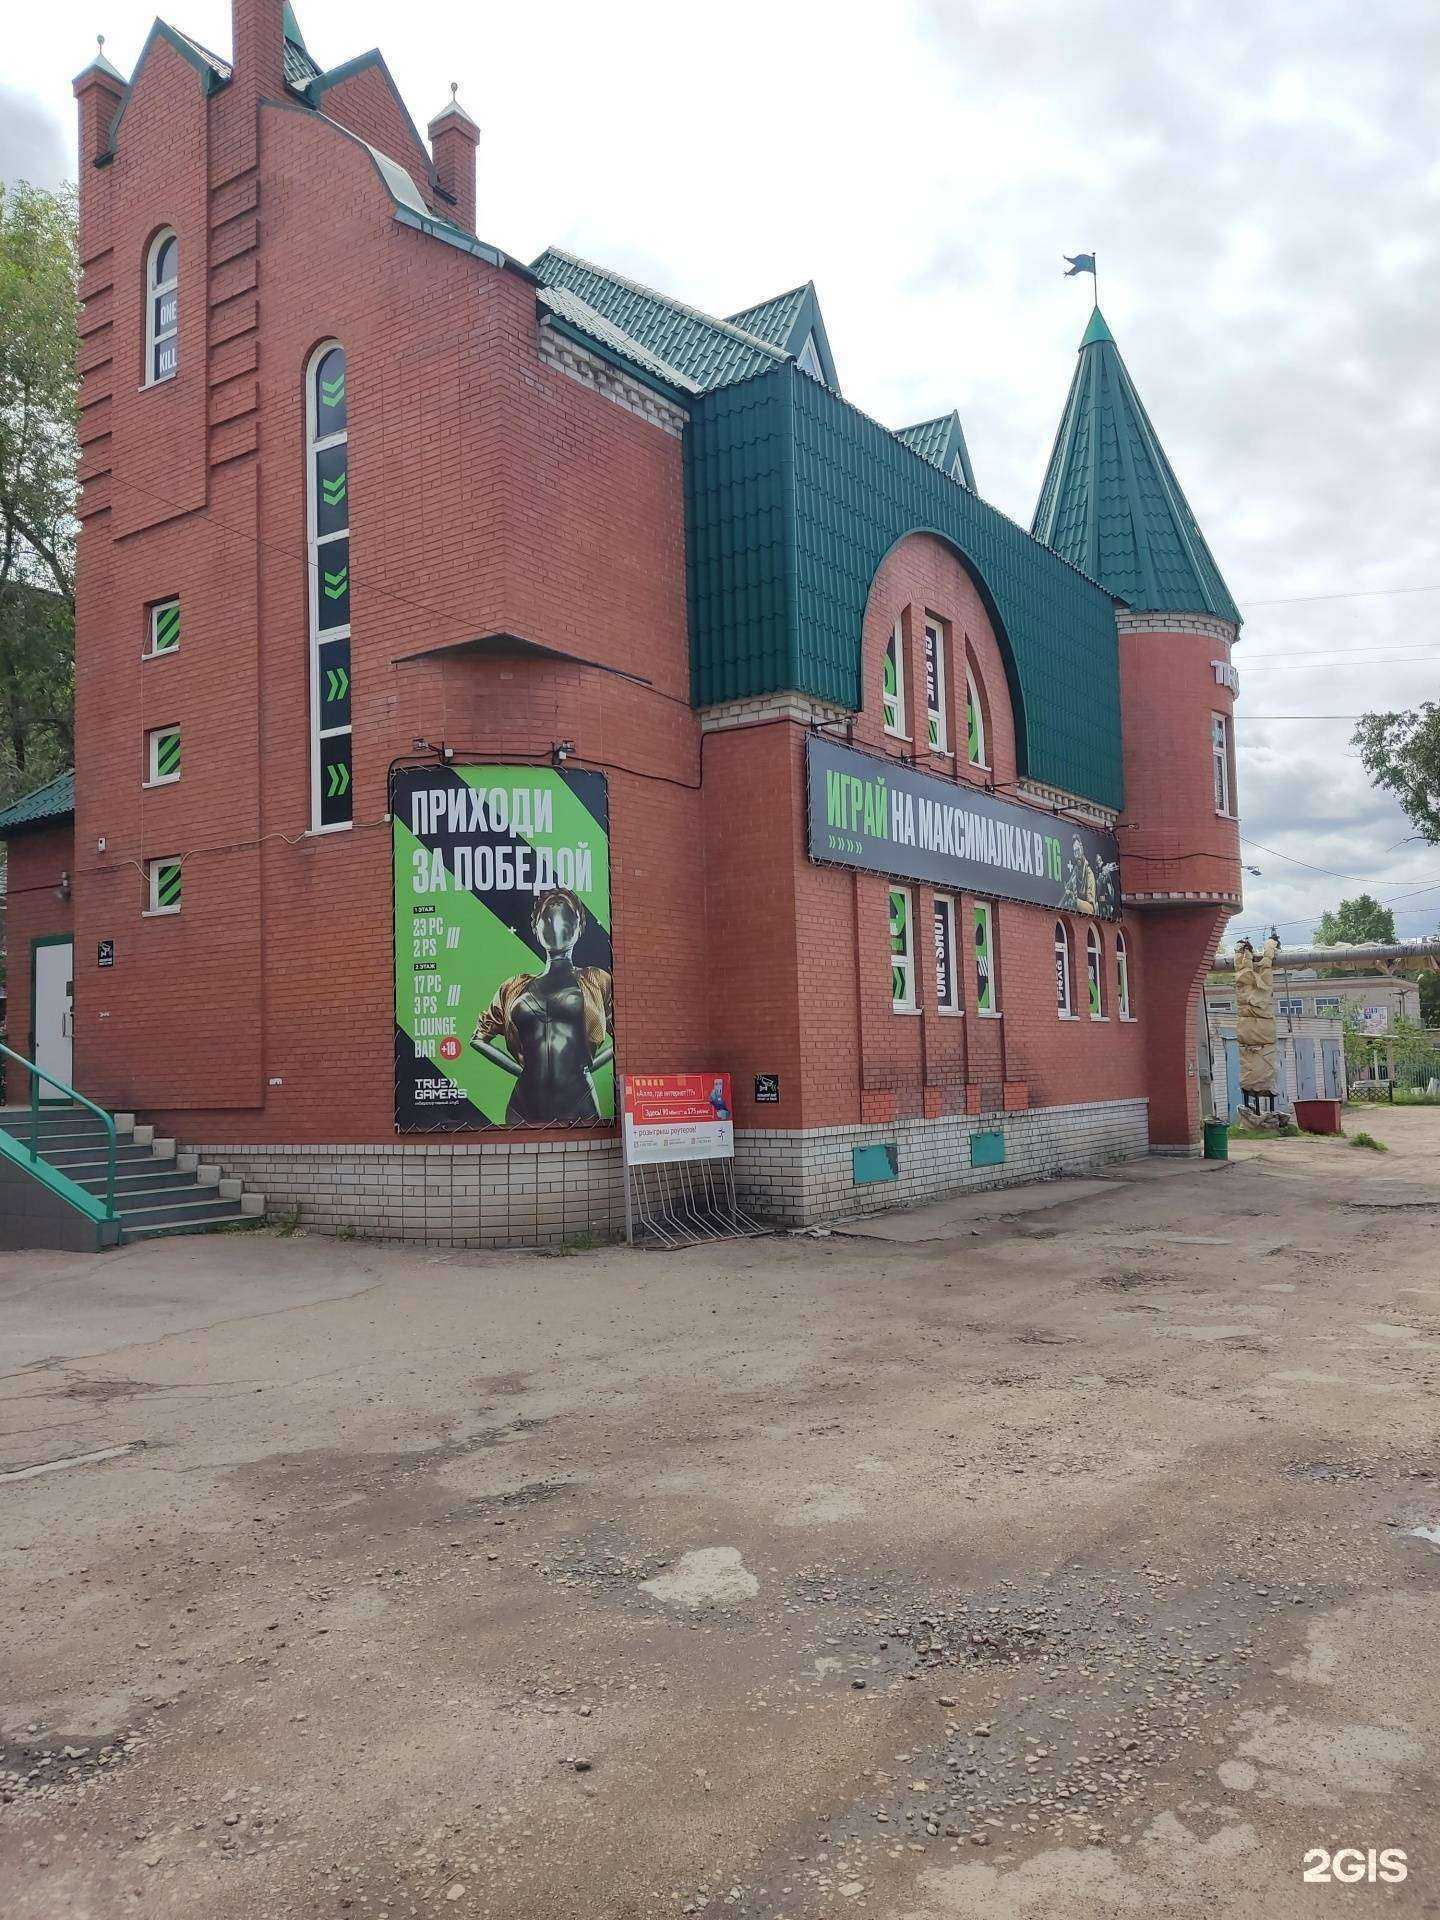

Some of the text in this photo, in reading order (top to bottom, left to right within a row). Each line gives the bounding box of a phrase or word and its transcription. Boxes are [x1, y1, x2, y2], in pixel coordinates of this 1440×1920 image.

[160, 301, 177, 326] ONE
[160, 348, 177, 372] KILL
[411, 787, 553, 838] ПРИХОДИ
[826, 769, 888, 840] ИГРАЙ
[892, 789, 916, 847] НА
[919, 797, 1034, 875] МАКСИМАЛКАХ
[1034, 832, 1044, 877] В
[412, 841, 593, 896] ЗА ПОБЕДОЙ
[412, 917, 444, 937] 23 PC
[413, 938, 437, 957] 2 PS
[414, 974, 442, 994] 17 PC
[414, 995, 438, 1015] 3 PS
[414, 1016, 457, 1037] LOUNGE
[414, 1039, 436, 1058] BAR
[414, 1078, 449, 1089] TRUE
[414, 1089, 468, 1100] GAMERS
